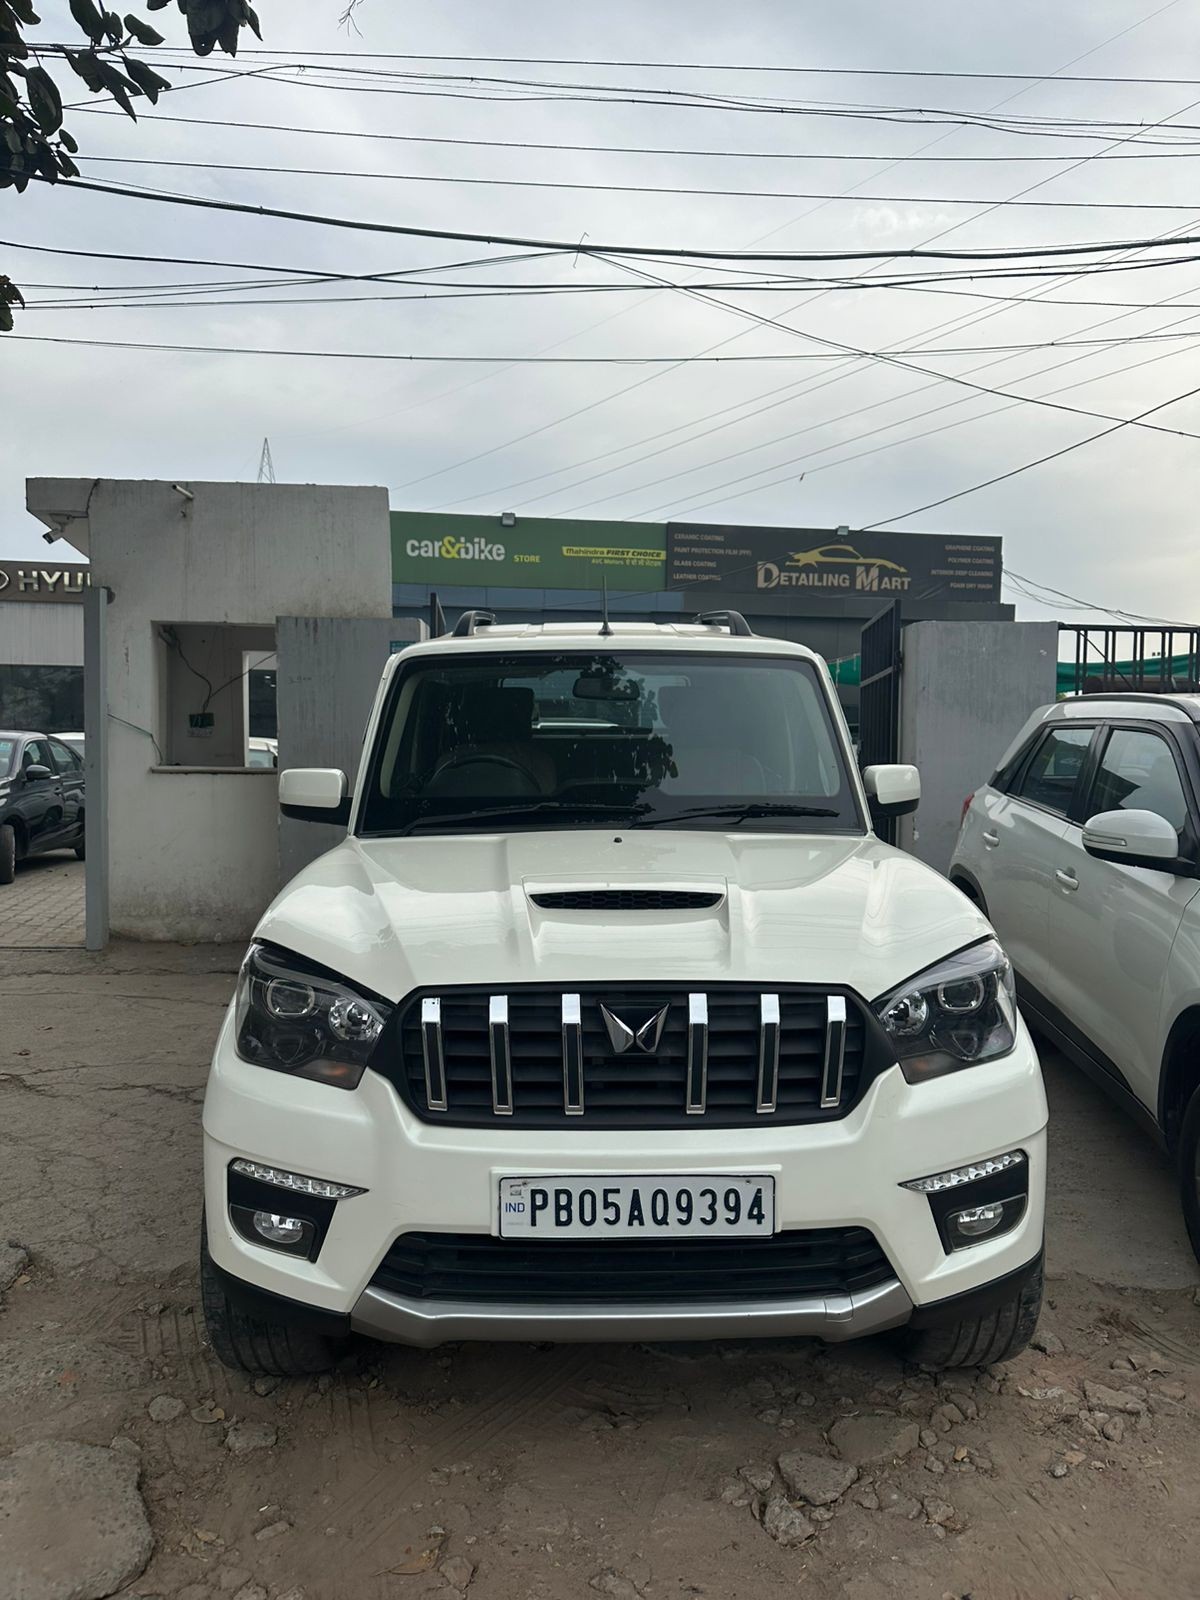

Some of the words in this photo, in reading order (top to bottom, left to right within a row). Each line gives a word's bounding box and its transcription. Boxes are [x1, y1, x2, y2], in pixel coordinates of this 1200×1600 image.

[406, 535, 505, 561] car&bike
[606, 549, 630, 557] FIRST
[690, 547, 724, 555] PROTECTION
[514, 554, 540, 563] STORE
[18, 570, 91, 592] HYU
[505, 1202, 526, 1213] IND
[530, 1187, 765, 1227] PB05AQ9394
